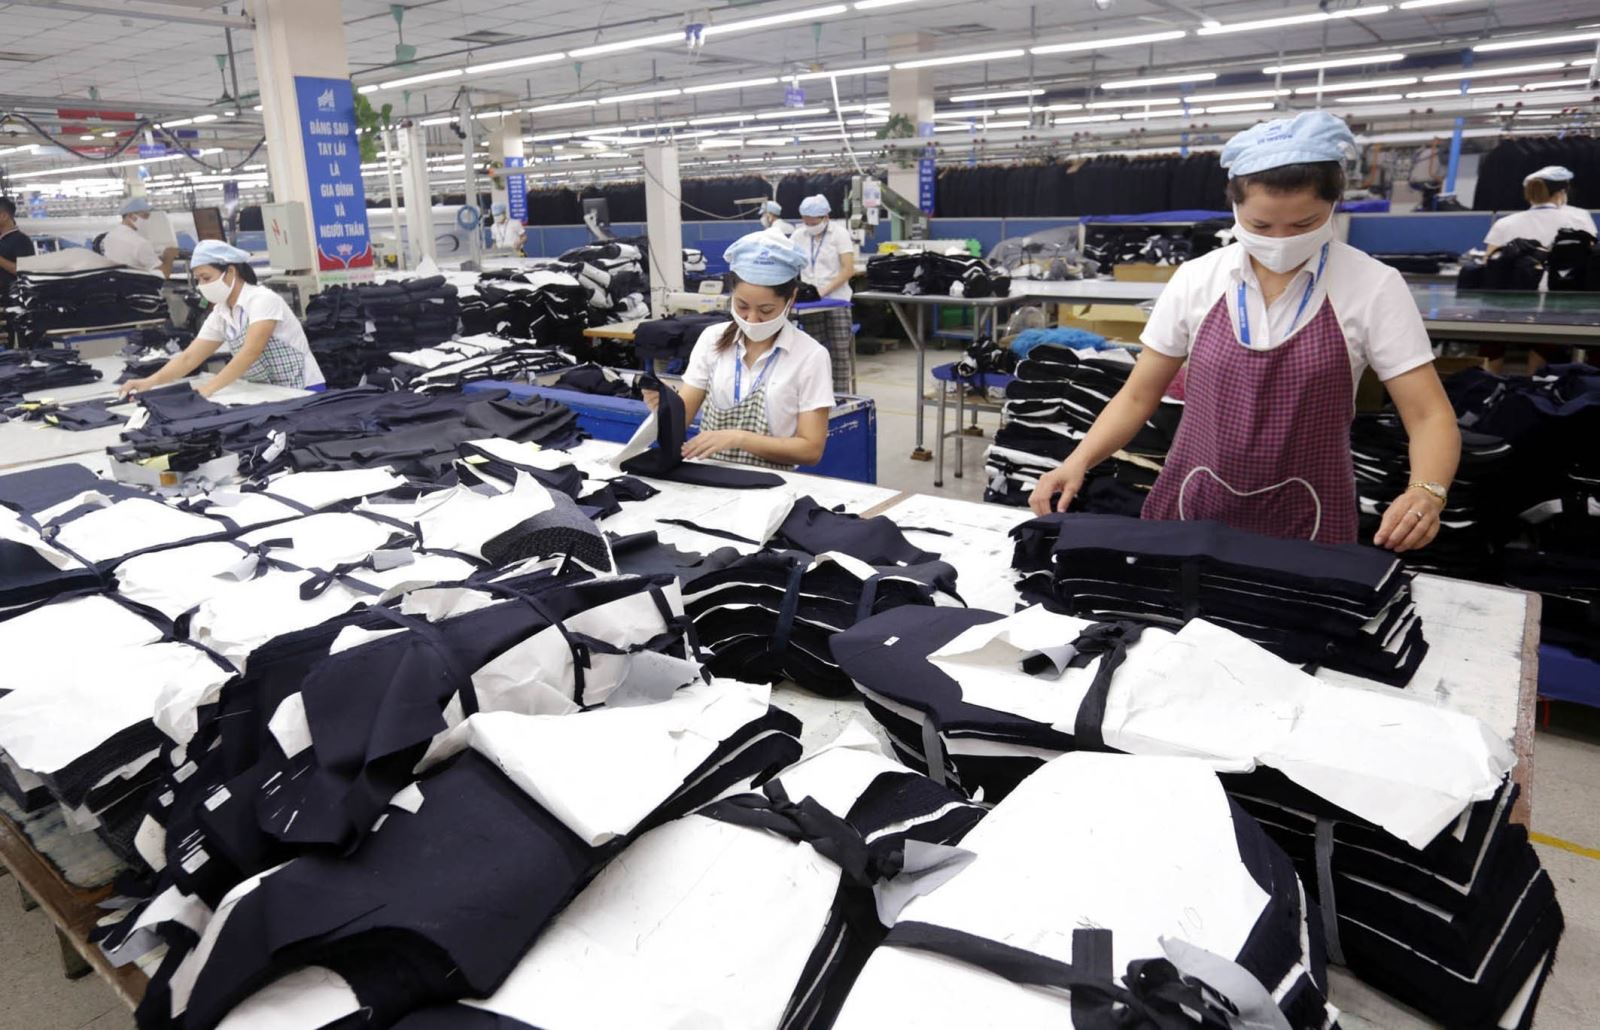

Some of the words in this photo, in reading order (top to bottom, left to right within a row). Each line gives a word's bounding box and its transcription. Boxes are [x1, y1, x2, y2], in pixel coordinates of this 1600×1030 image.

[333, 122, 348, 136] SAU
[318, 142, 332, 156] TAY
[334, 141, 346, 156] LÁI
[330, 161, 340, 176] LÀ
[320, 184, 334, 196] GIA
[336, 182, 354, 196] ĐÌNH
[334, 202, 345, 216] VÀ
[320, 222, 344, 238] NGƯỜI
[344, 221, 364, 236] THÂN
